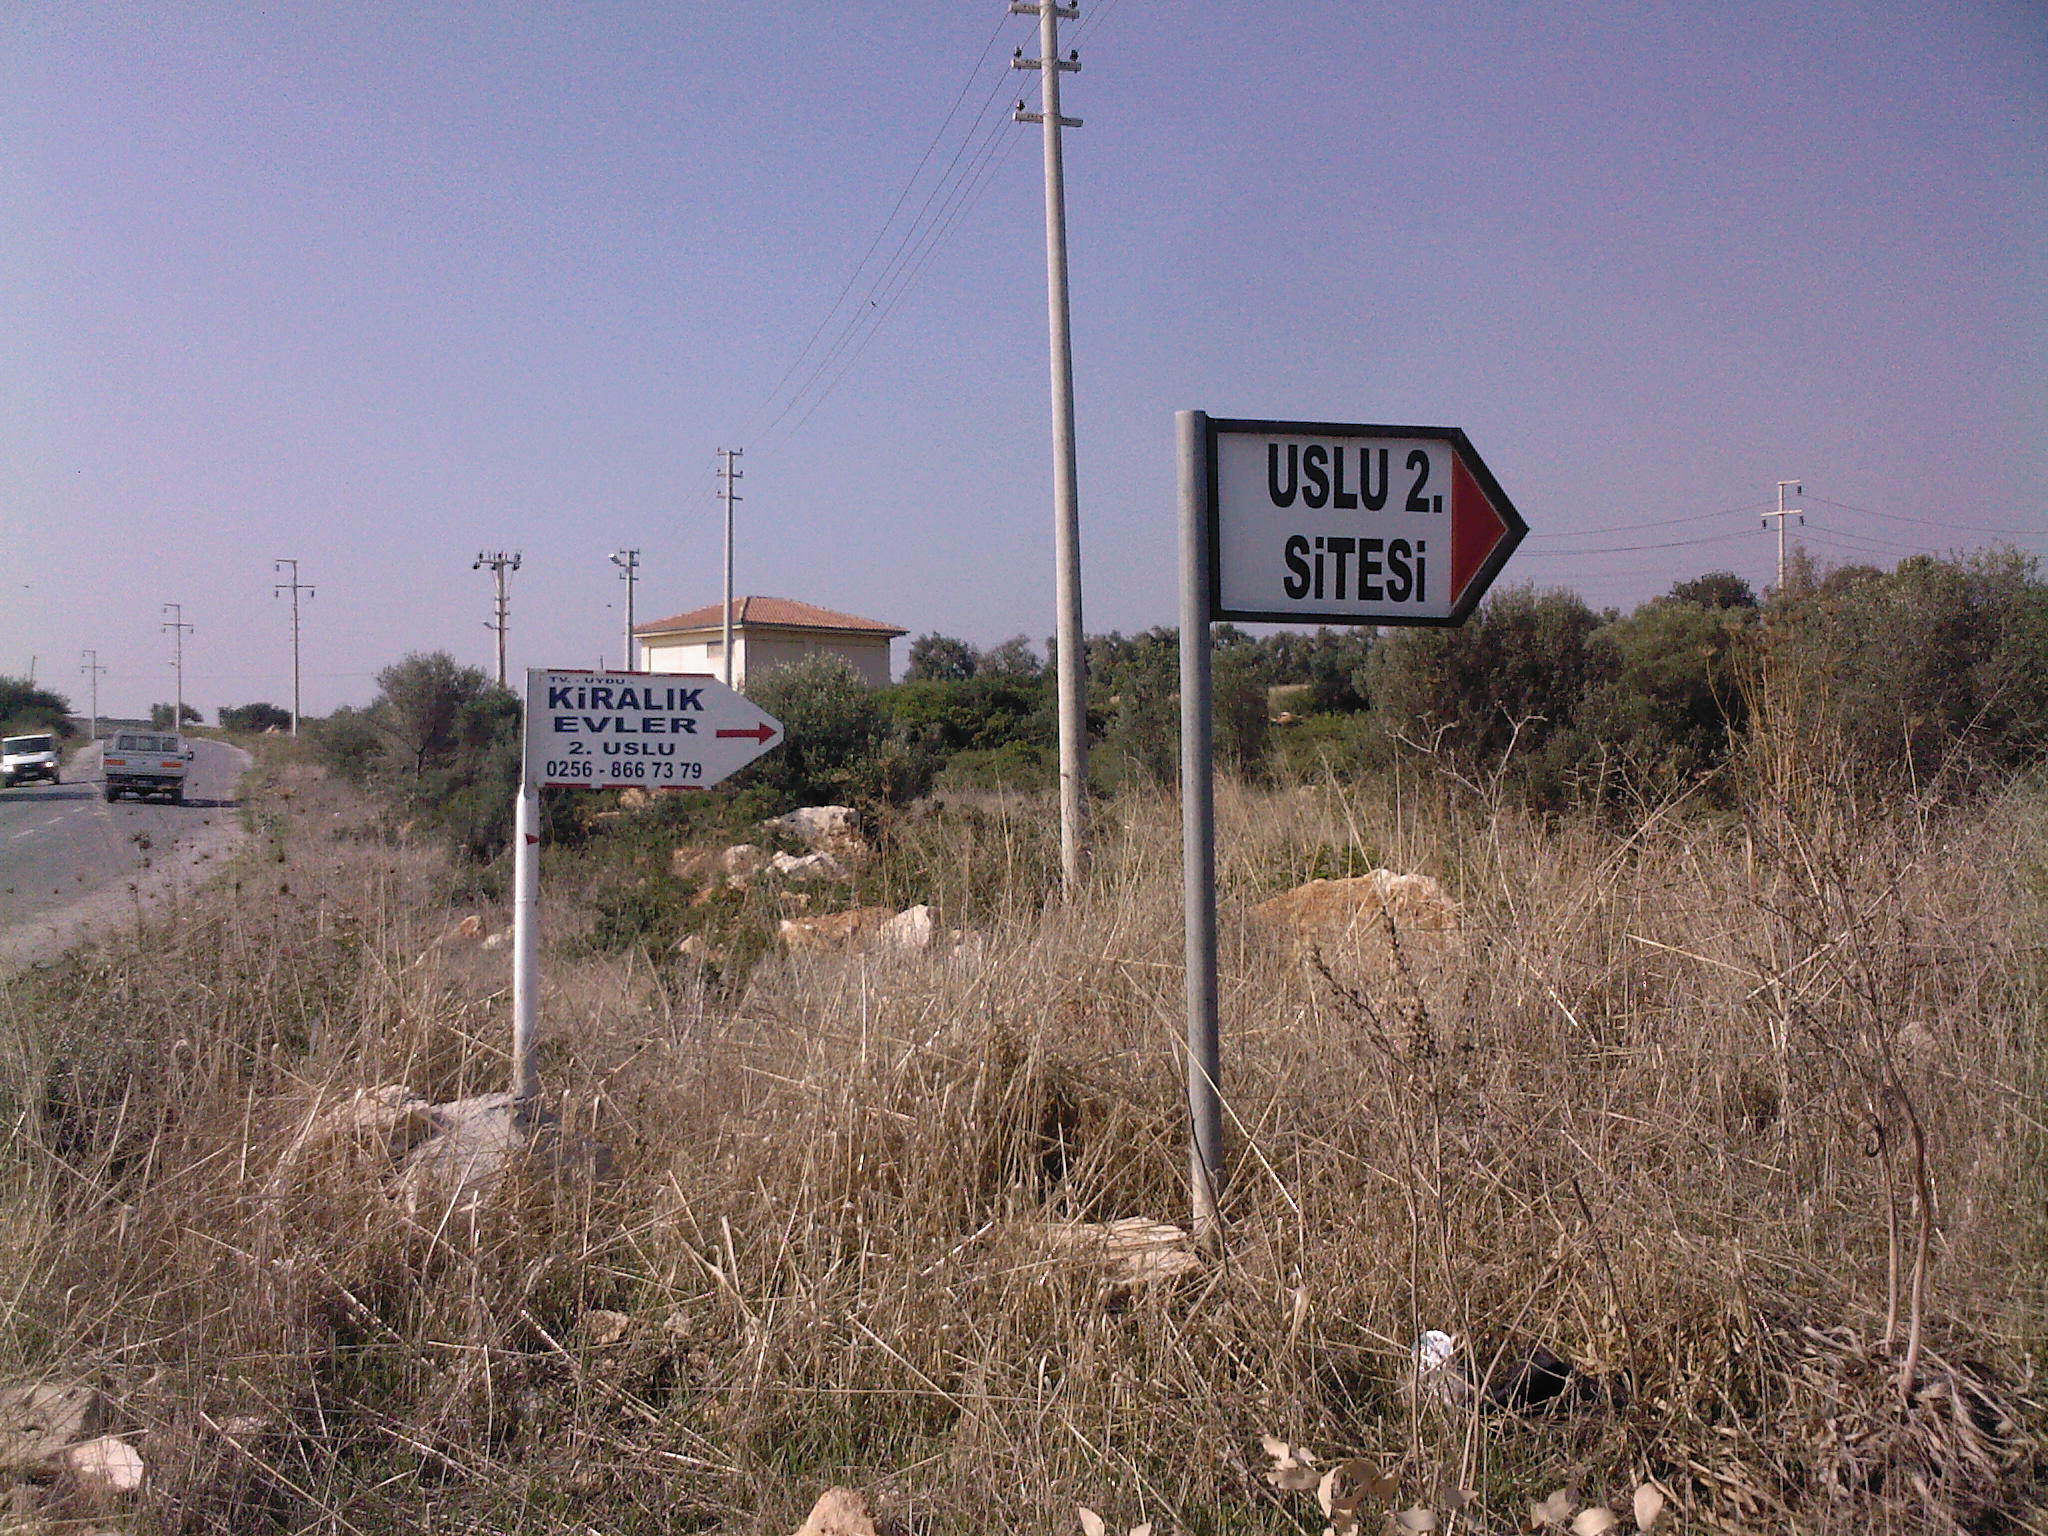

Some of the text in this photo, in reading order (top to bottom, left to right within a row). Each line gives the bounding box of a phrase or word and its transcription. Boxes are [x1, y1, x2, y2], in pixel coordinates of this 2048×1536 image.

[1268, 443, 1443, 513] USLU 2.
[554, 716, 698, 734] EVLER
[568, 742, 675, 755] 2. USLU
[546, 761, 592, 777] 0256
[611, 761, 645, 778] 866
[652, 762, 673, 778] 73
[681, 763, 702, 778] 79
